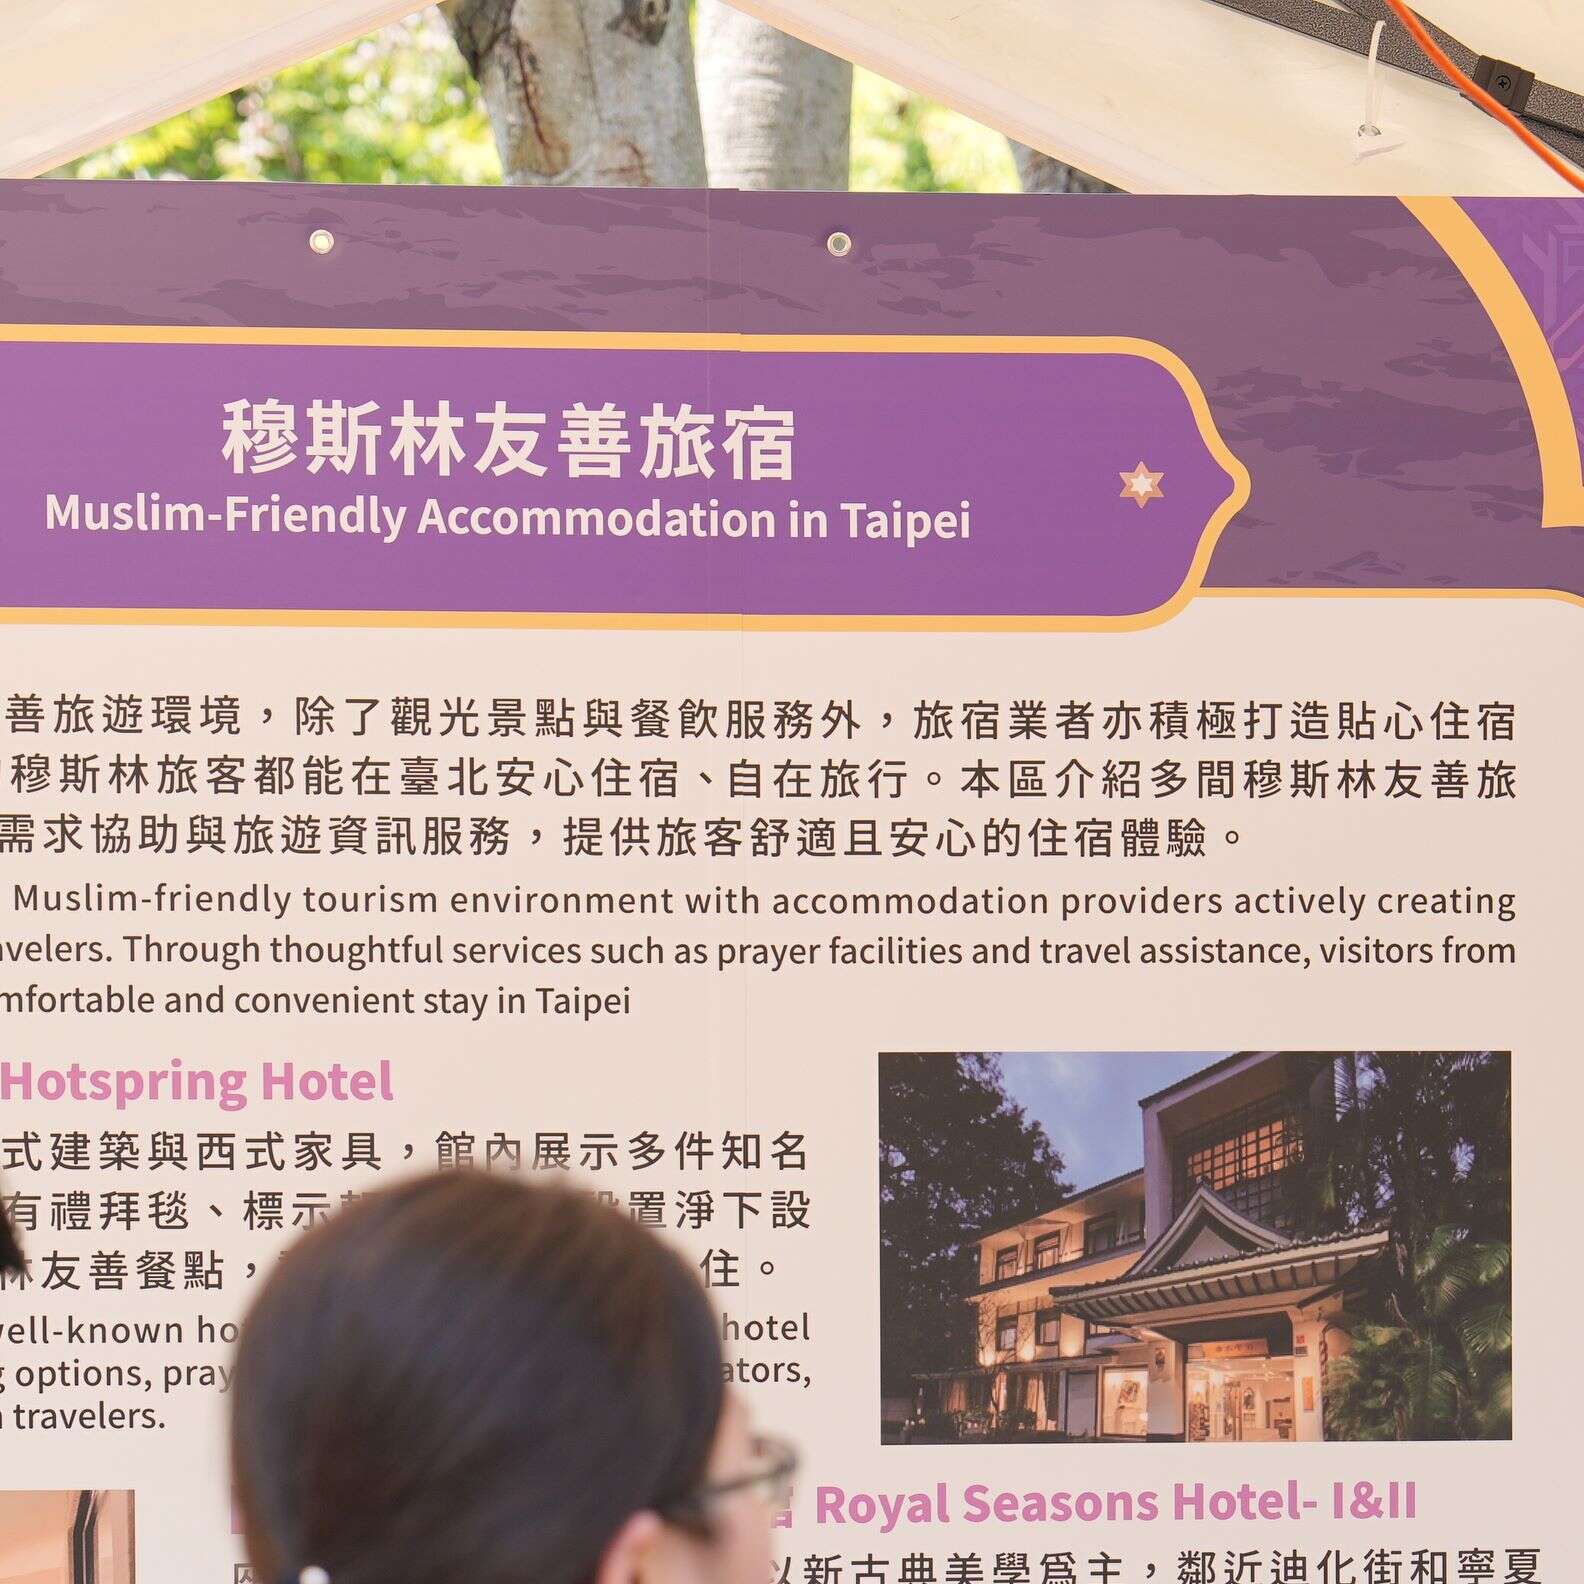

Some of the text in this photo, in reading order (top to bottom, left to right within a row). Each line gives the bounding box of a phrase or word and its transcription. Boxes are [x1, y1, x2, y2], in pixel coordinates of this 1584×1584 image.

[219, 397, 797, 482] 穆斯林友善旅宿
[47, 492, 969, 547] Muslim-Friendly Accommodation in Taipei
[15, 883, 291, 919] Muslim-friendly
[303, 885, 436, 912] tourism
[451, 885, 673, 914] environment
[685, 886, 759, 914] with
[773, 886, 1047, 914] accommodation
[1063, 886, 1222, 921] providers
[1235, 886, 1366, 921] actively
[1378, 886, 1515, 922] creating
[123, 934, 259, 970] Through
[270, 934, 443, 971] thoughtful
[453, 936, 581, 963] services
[591, 936, 663, 964] such
[675, 944, 708, 964] as
[719, 944, 821, 972] prayer
[829, 936, 962, 964] facilities
[972, 936, 1029, 964] and
[1040, 936, 1130, 964] travel
[1140, 936, 1310, 969] assistance,
[1320, 936, 1433, 963] visitors
[1442, 935, 1515, 963] from
[165, 985, 223, 1013] and
[235, 986, 415, 1014] convenient
[424, 989, 488, 1021] stay
[498, 986, 525, 1013] in
[535, 986, 629, 1021] Taipei
[1, 1058, 247, 1112] Hotspring
[263, 1060, 394, 1101] Hotel
[6, 1190, 371, 1231] 有禮拜毯、標示
[722, 1312, 810, 1341] hotel
[16, 1358, 151, 1394] options,
[13, 1401, 166, 1431] travelers.
[817, 1482, 950, 1533] Royal
[964, 1484, 1159, 1524] Seasons
[1174, 1479, 1317, 1520] Hotel-
[1334, 1481, 1417, 1520] I&II
